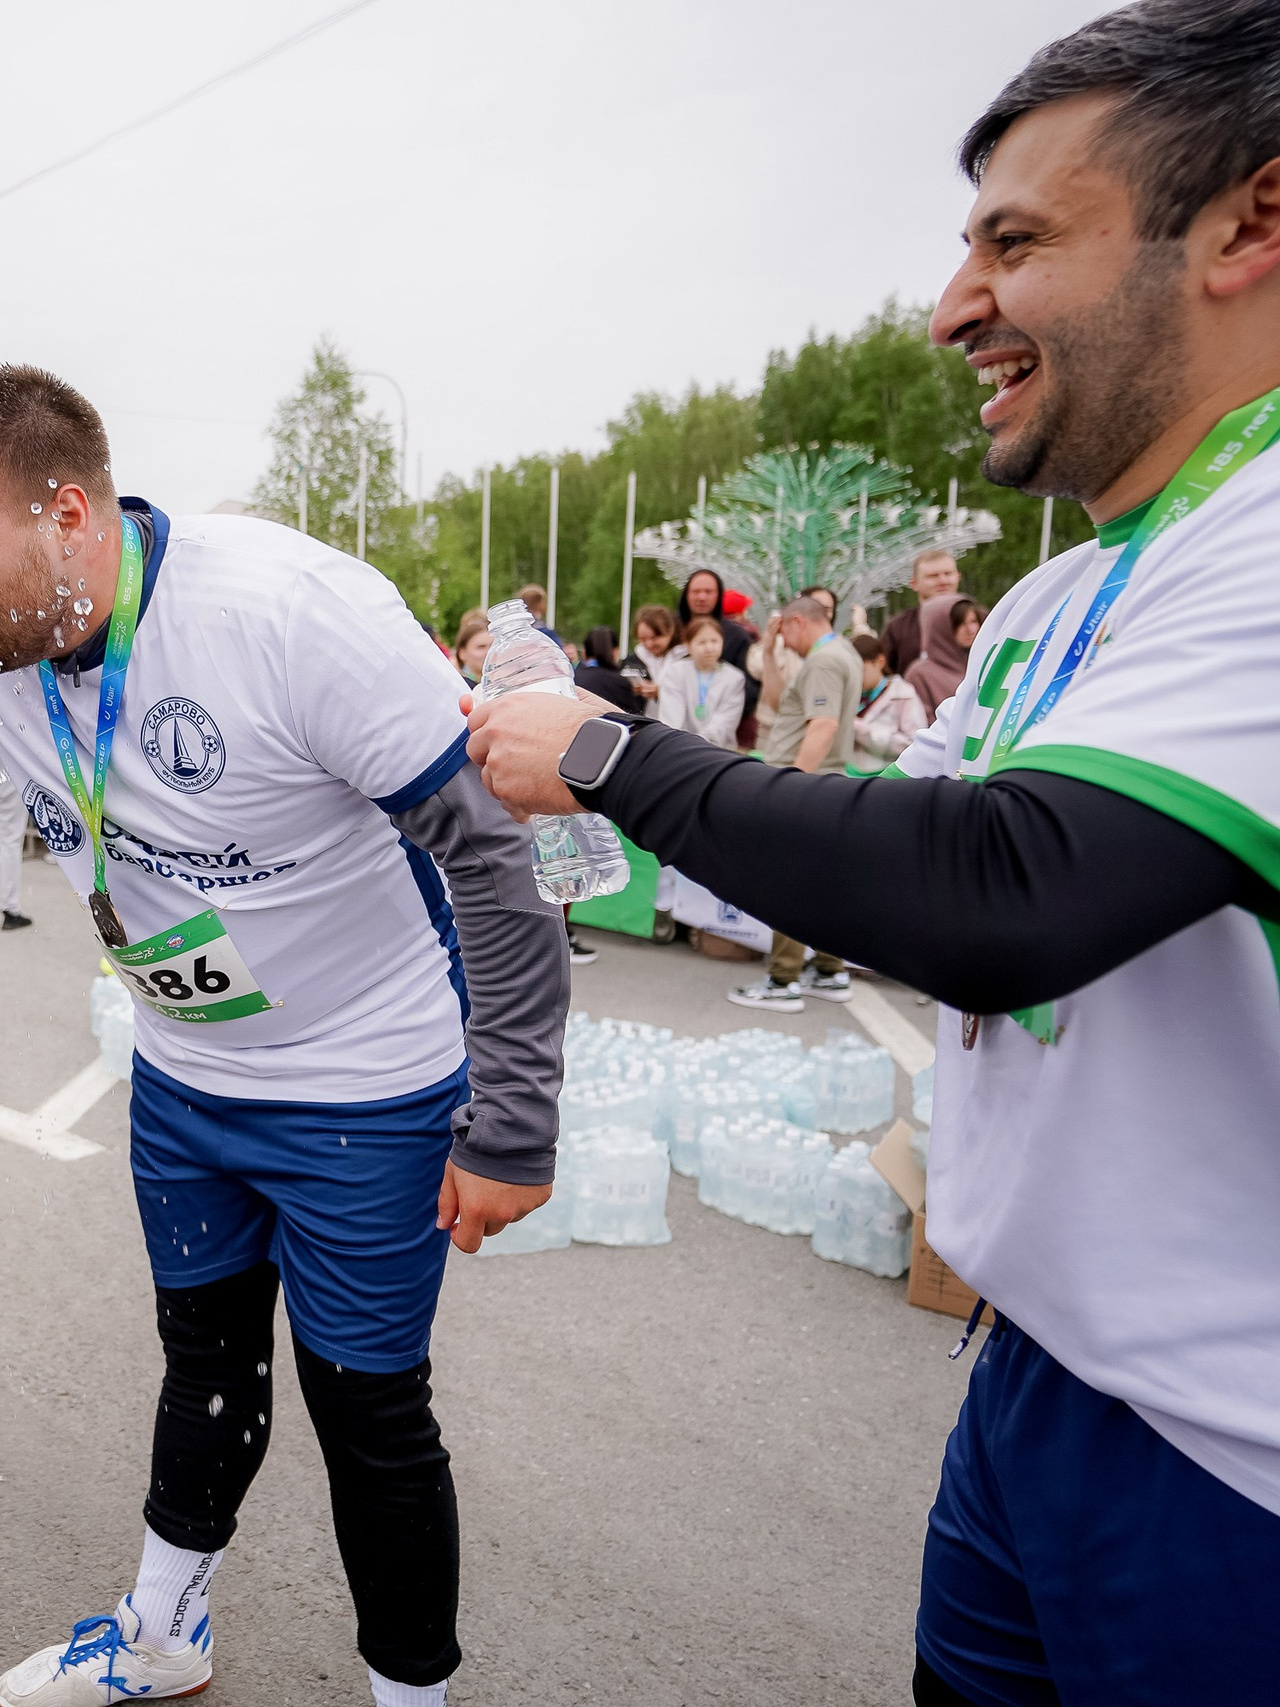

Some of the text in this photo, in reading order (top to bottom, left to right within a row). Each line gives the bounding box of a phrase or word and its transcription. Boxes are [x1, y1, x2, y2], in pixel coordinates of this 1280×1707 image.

[1206, 402, 1277, 472] 185 лет
[122, 565, 135, 606] 185 лет
[1084, 601, 1108, 635] Utair
[48, 694, 60, 715] Utair
[106, 686, 115, 707] Utair
[148, 702, 206, 730] САМАРОВО
[65, 752, 77, 779] СБЕР
[98, 743, 106, 771] СБЕР
[42, 834, 76, 851] САРЕЙ
